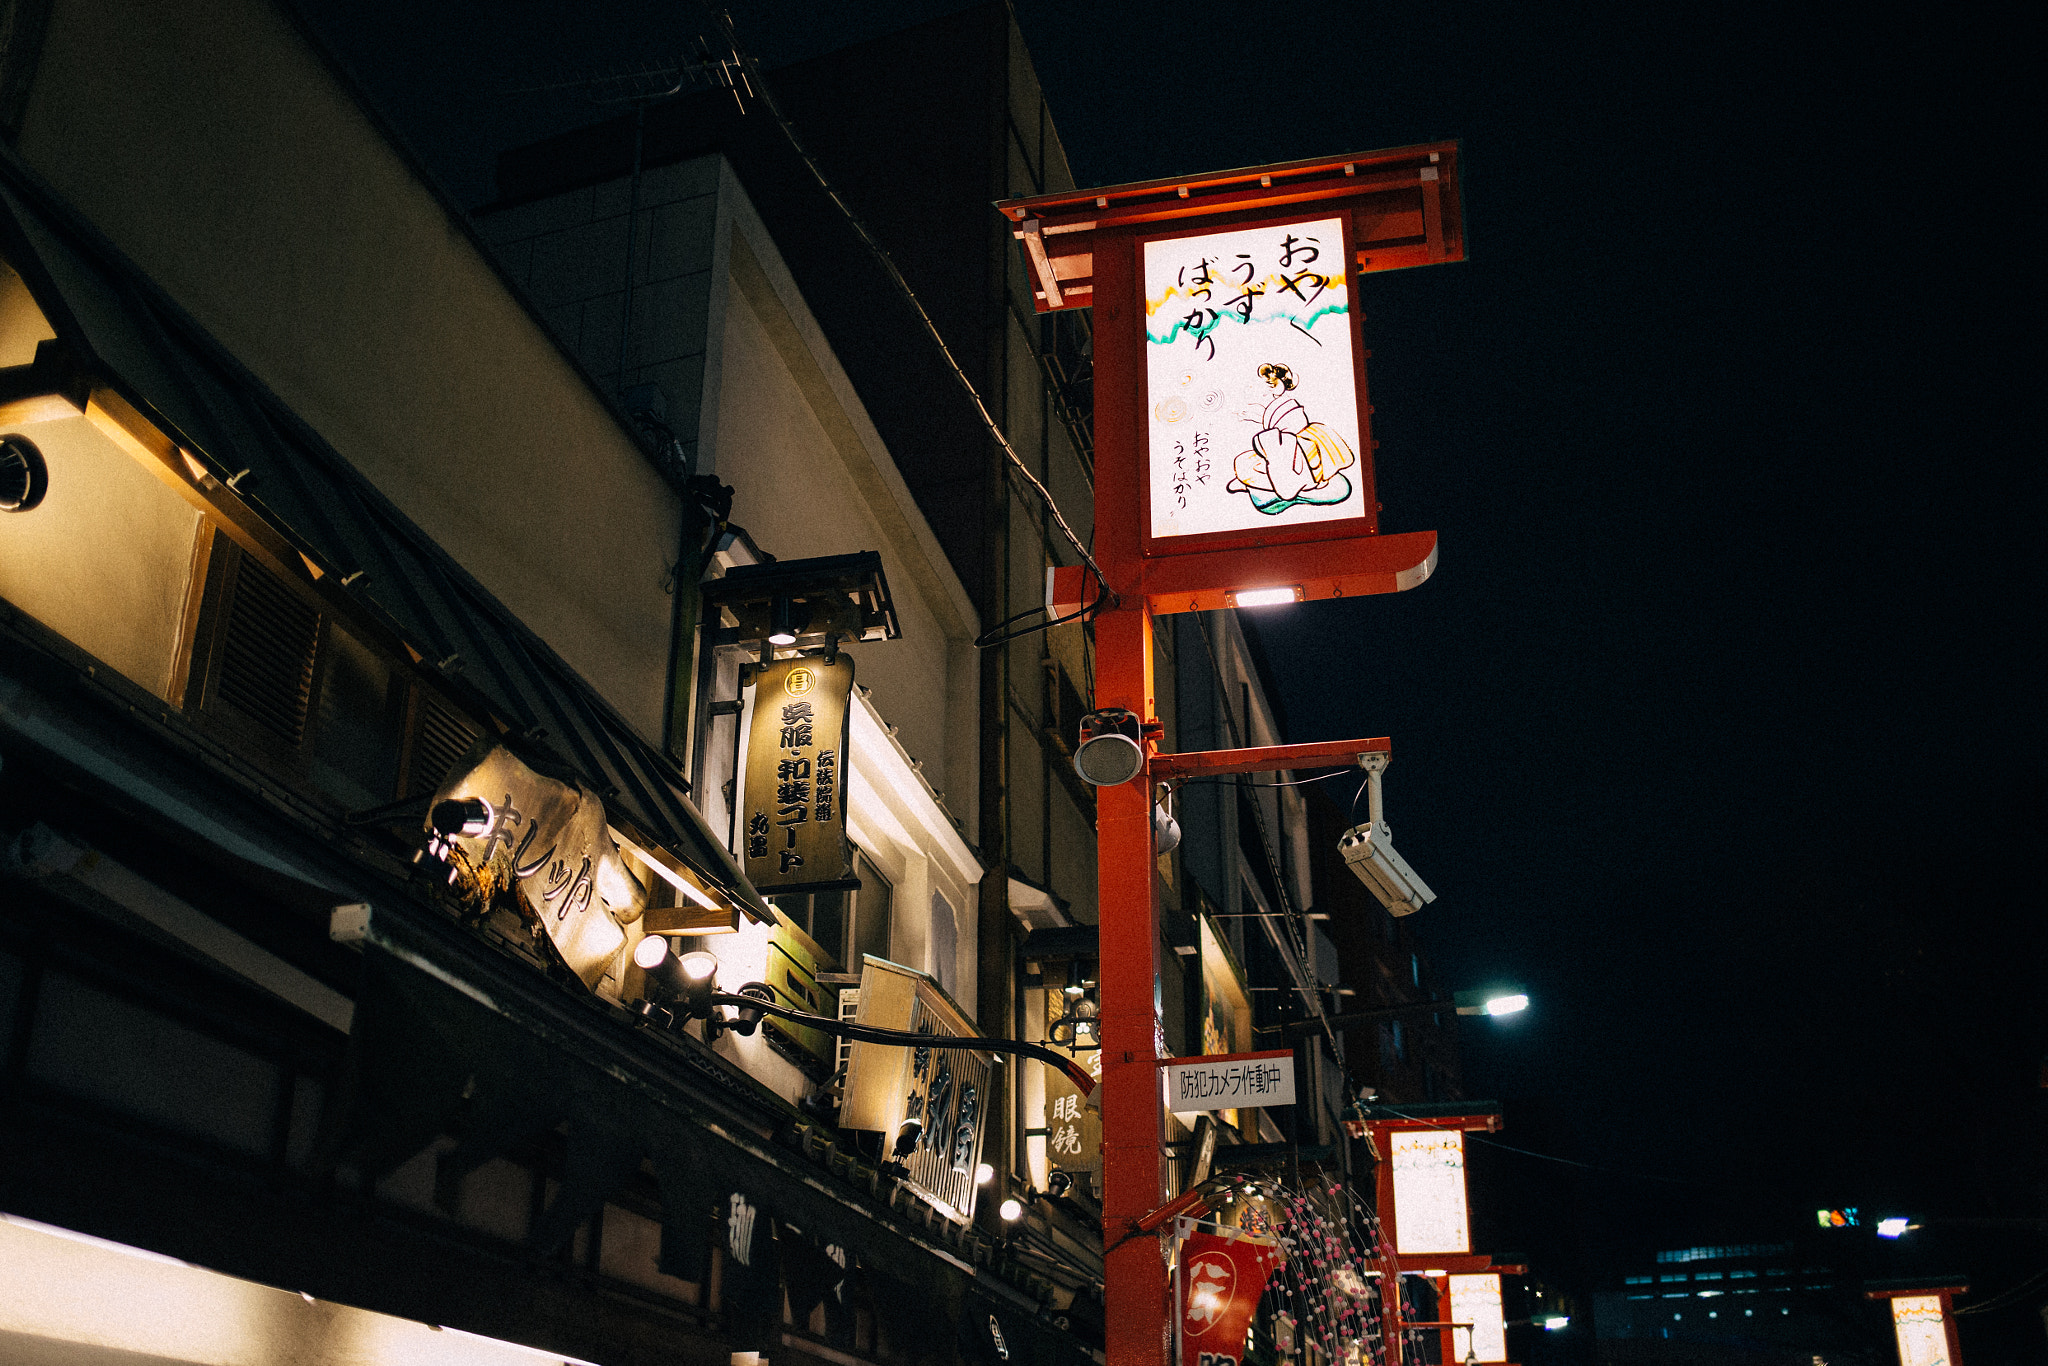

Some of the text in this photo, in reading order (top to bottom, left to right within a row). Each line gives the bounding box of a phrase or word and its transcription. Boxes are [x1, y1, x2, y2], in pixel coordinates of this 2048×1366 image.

[1177, 255, 1220, 362] ばっかり
[776, 701, 814, 875] 呉服・和装コート
[1051, 1093, 1083, 1156] 眼鏡
[1180, 1063, 1281, 1101] 防犯カメラ作動中
